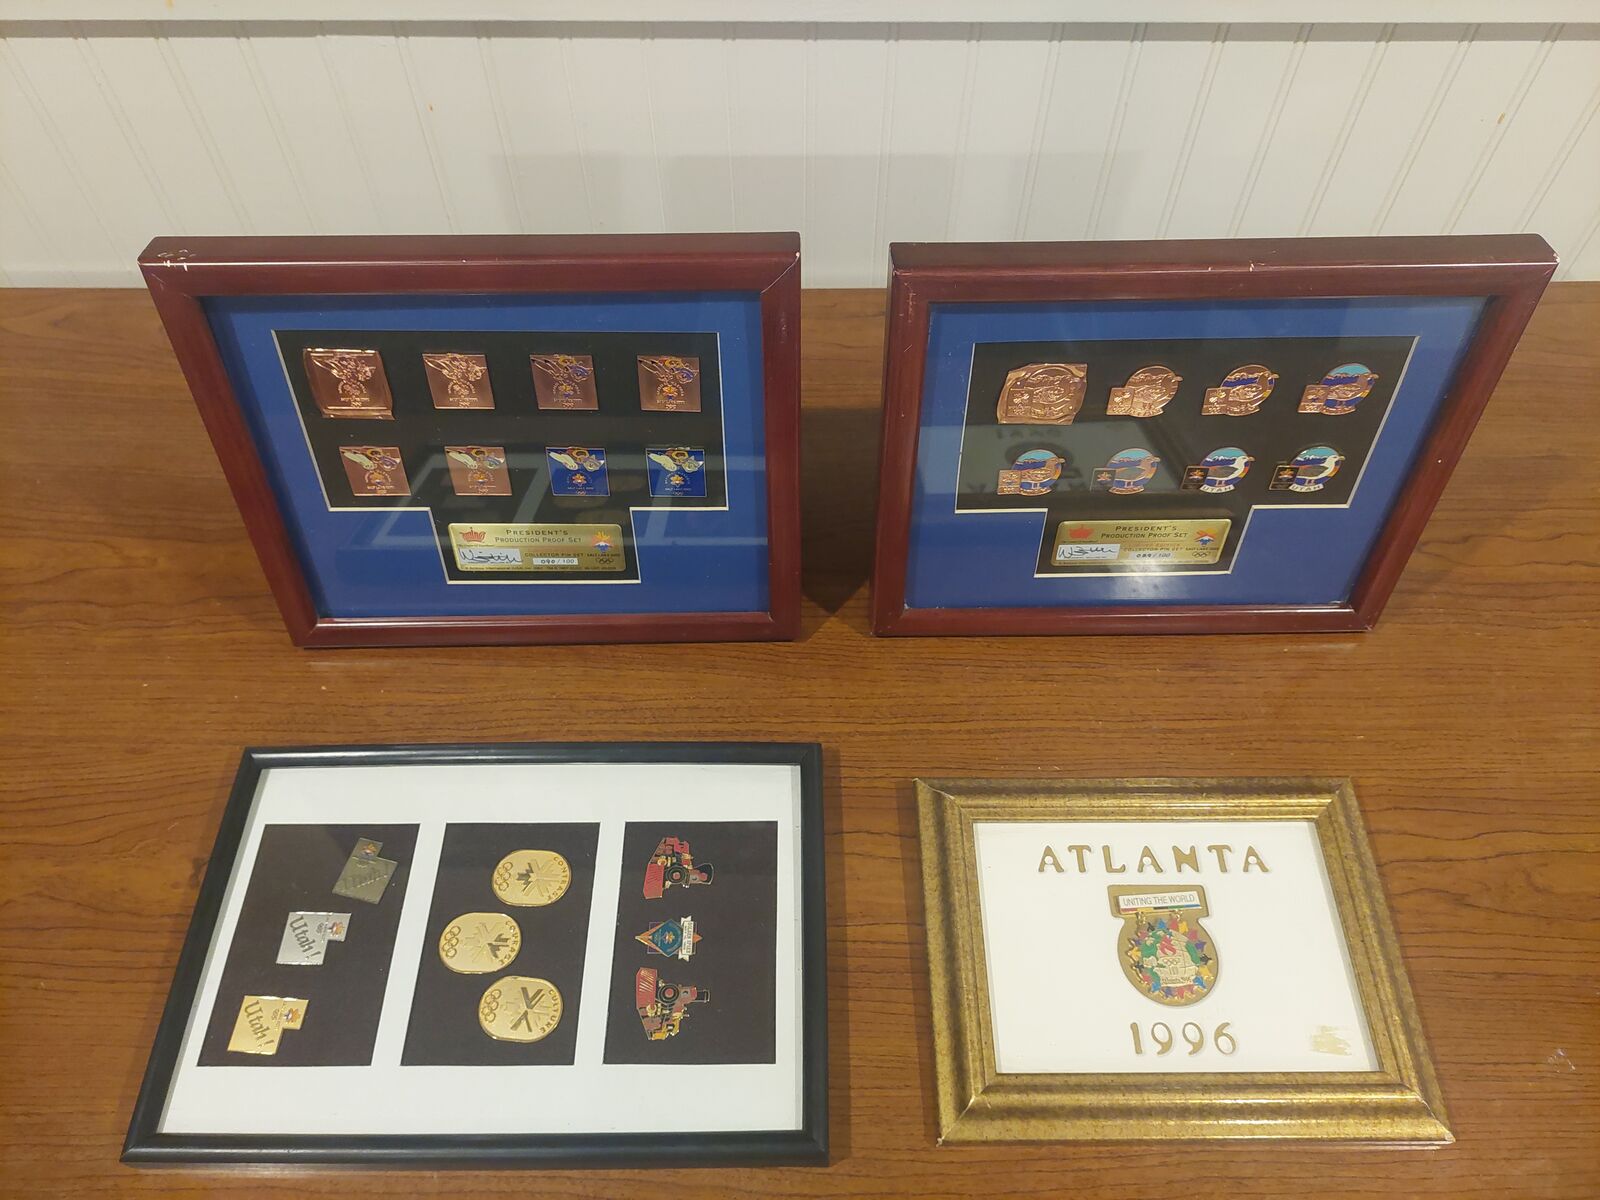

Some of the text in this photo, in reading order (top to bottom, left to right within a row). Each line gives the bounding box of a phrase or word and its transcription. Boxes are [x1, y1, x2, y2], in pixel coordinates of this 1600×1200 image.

[1038, 845, 1270, 873] ATLANTA
[549, 856, 568, 901] CONTRAST
[1122, 893, 1195, 906] UNITING THE WORLD
[539, 989, 558, 1034] CULTURE
[1130, 1022, 1237, 1055] 1996
